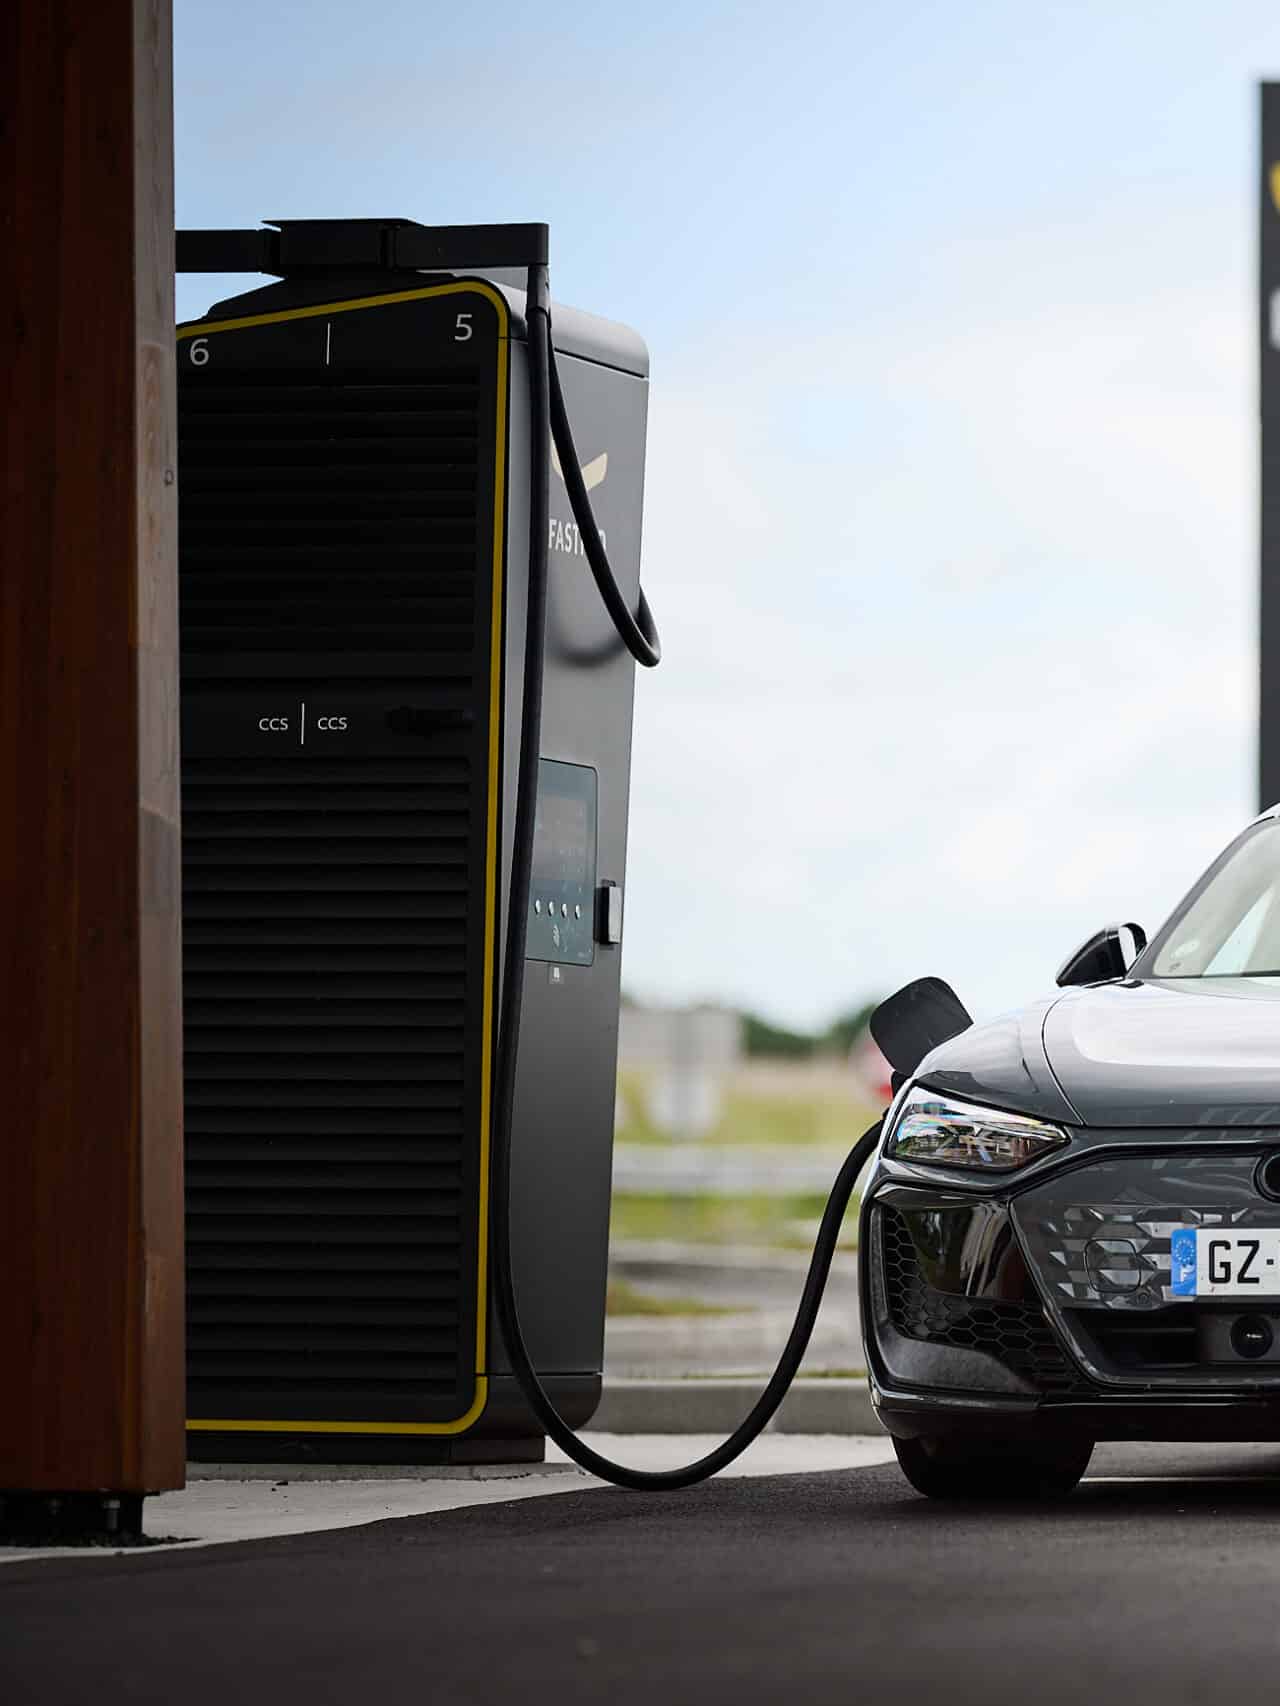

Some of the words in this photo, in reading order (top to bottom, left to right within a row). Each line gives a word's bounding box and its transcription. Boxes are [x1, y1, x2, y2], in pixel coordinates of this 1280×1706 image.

[454, 313, 473, 341] 5
[190, 338, 209, 366] 6
[548, 518, 607, 556] FAST
[258, 717, 289, 731] CCS
[317, 716, 348, 730] CCS
